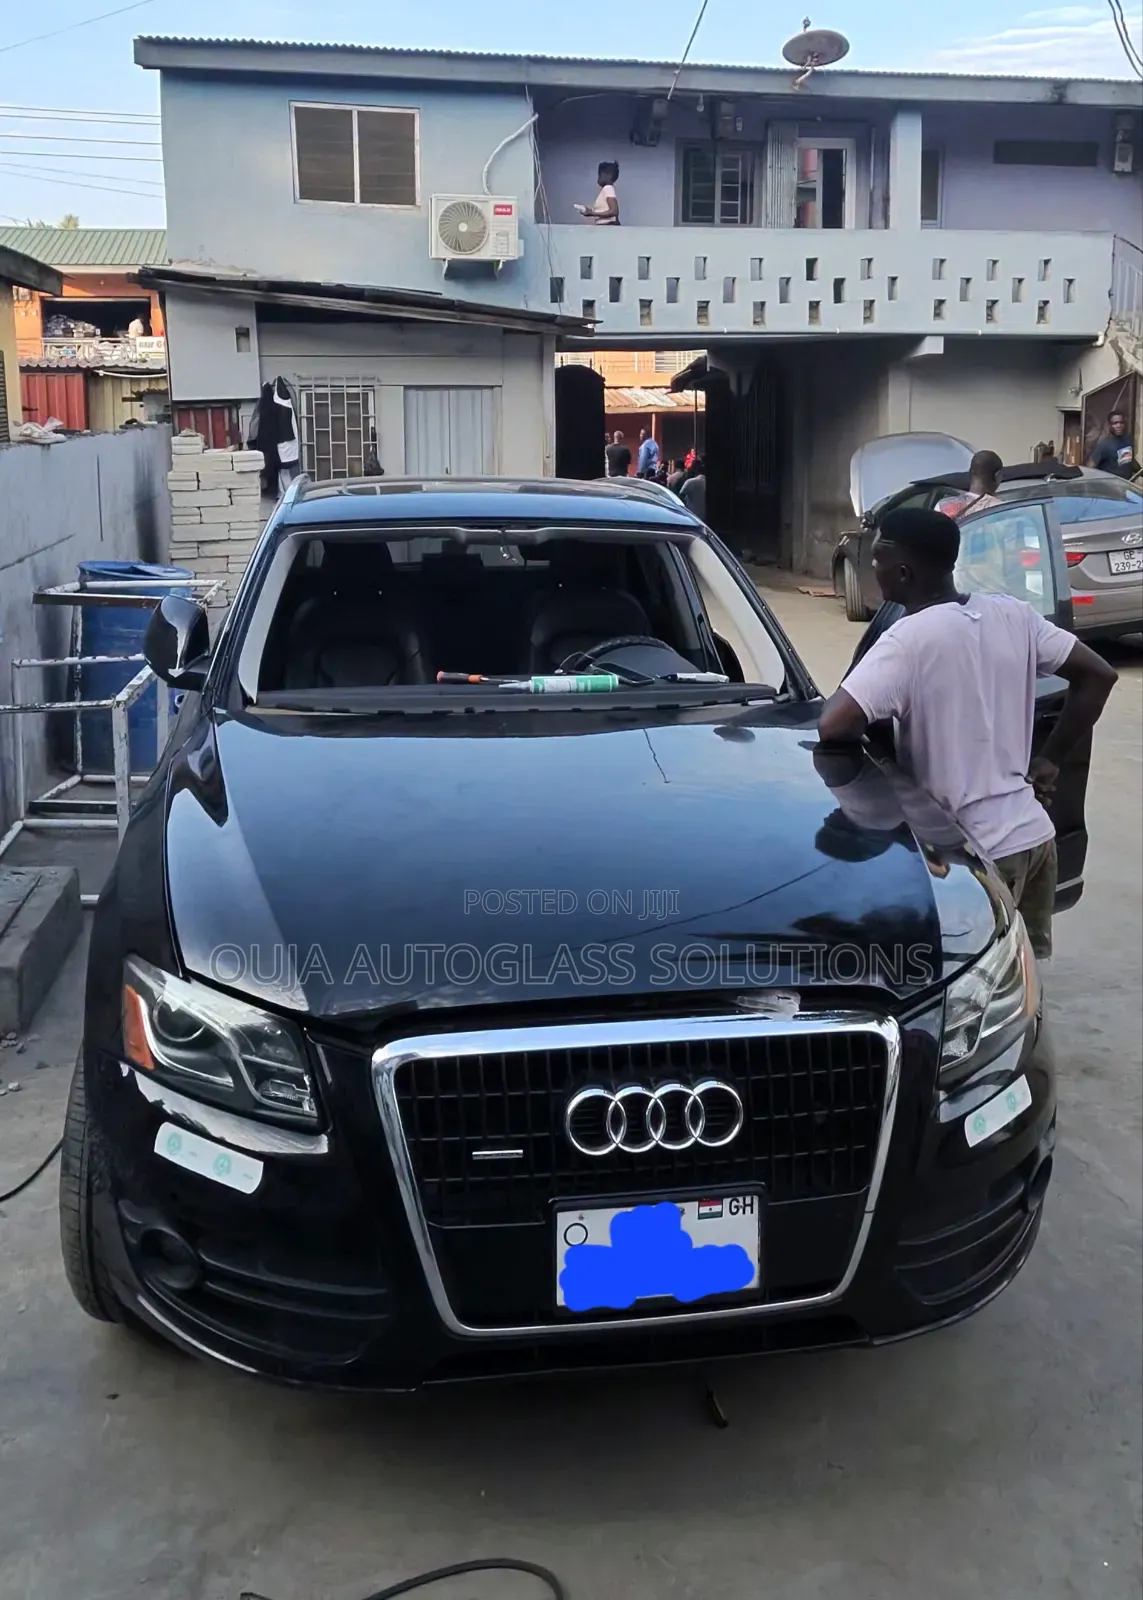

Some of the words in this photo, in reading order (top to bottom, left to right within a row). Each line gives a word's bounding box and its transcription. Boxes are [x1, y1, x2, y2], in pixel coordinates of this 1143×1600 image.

[1123, 550, 1136, 560] GE
[1114, 560, 1143, 572] 239-2
[728, 1196, 755, 1216] GH
